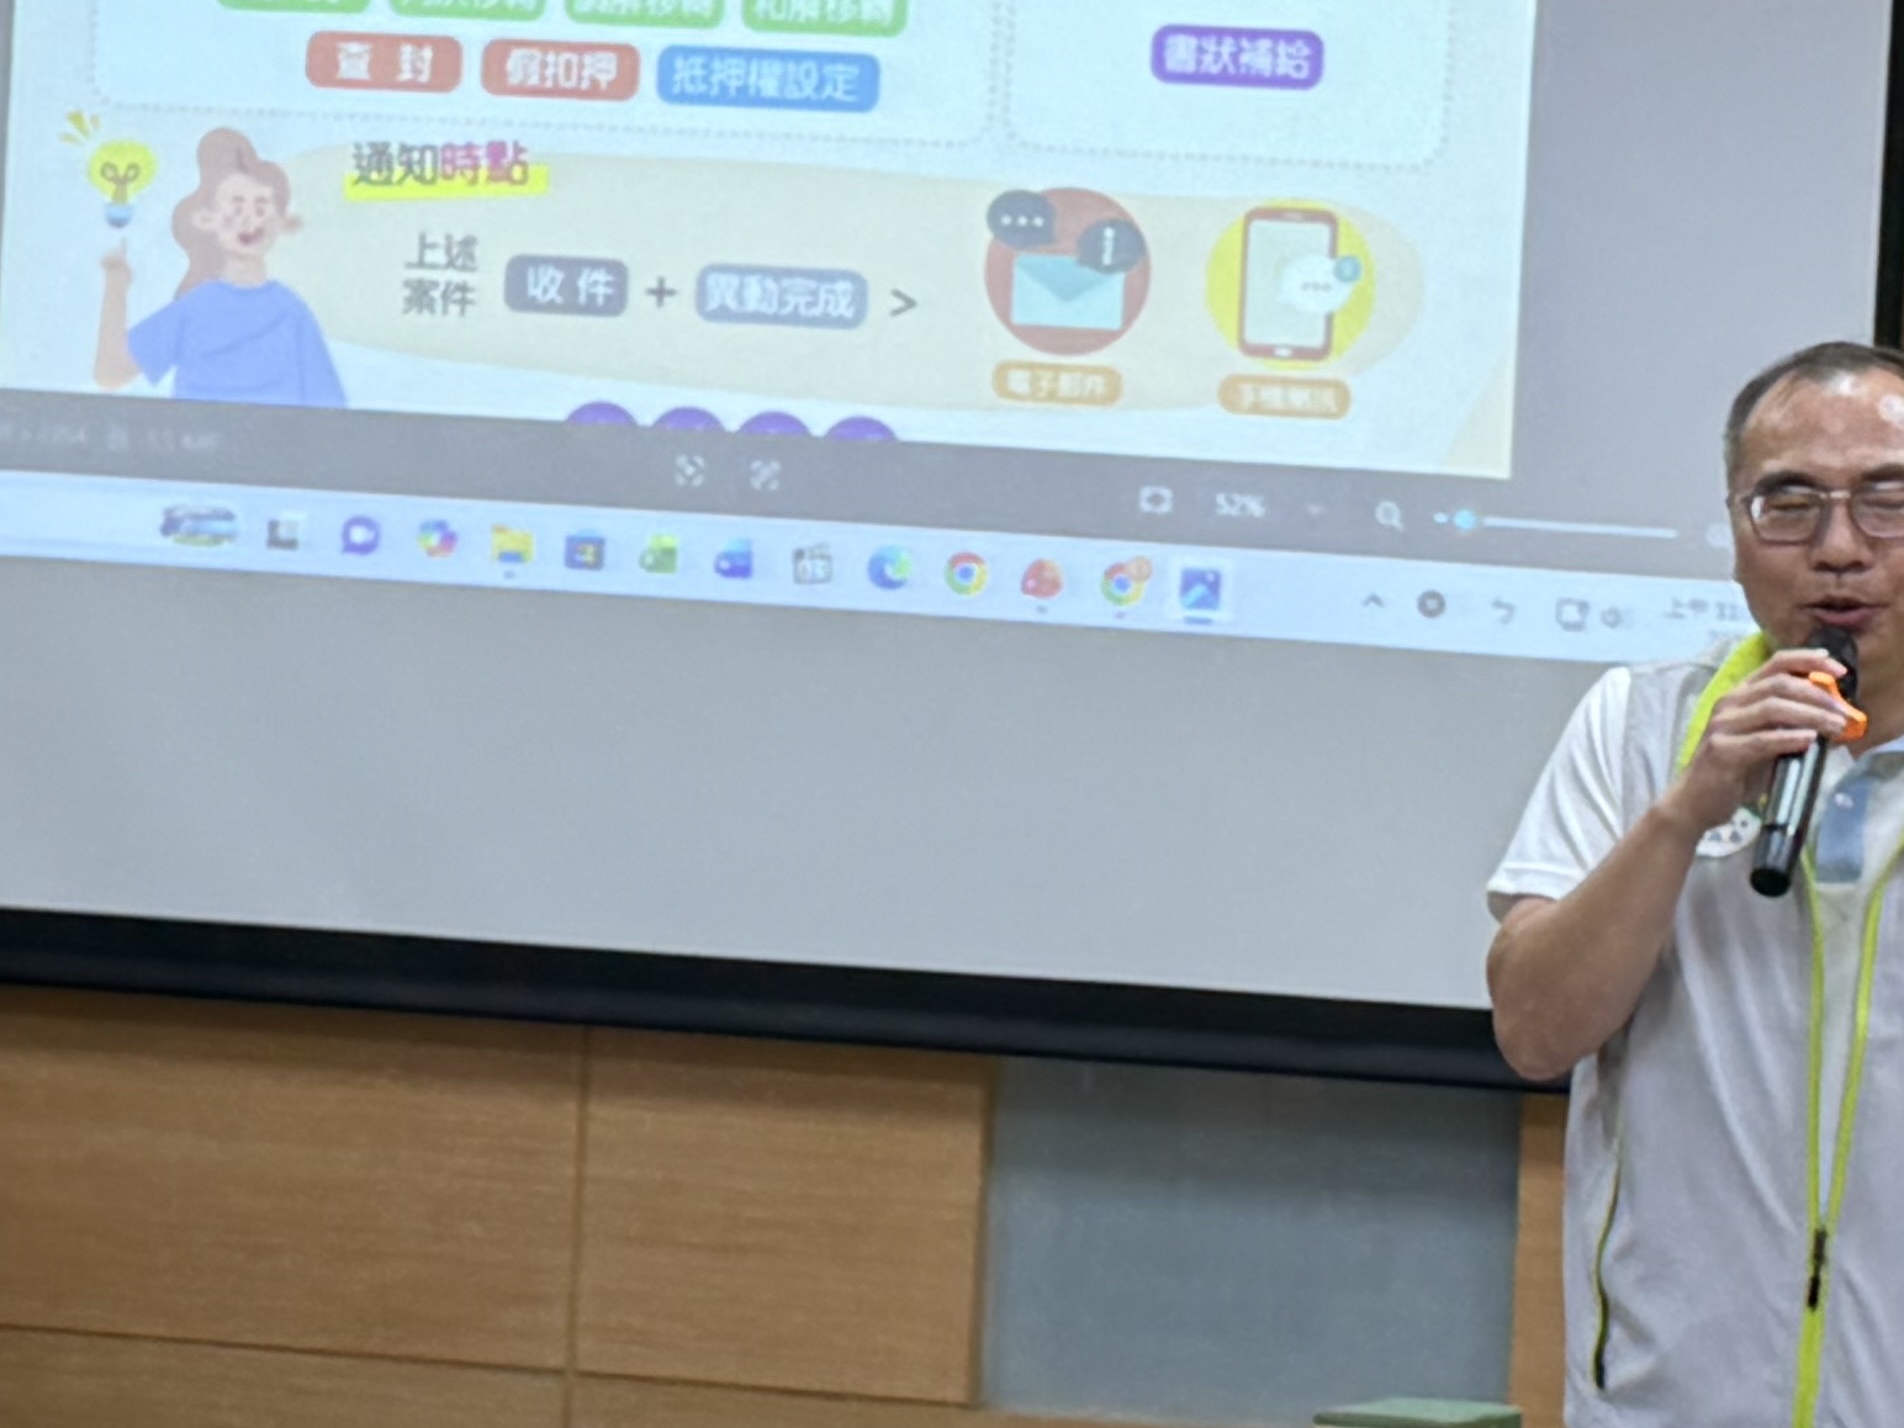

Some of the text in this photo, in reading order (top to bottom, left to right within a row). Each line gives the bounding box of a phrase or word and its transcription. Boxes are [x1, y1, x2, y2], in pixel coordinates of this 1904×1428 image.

[672, 52, 861, 103] 抵押權設定
[351, 141, 530, 188] 通知時點
[406, 234, 479, 272] 上述
[402, 278, 476, 319] 案件
[526, 268, 616, 304] 收件
[1216, 492, 1264, 518] 52%
